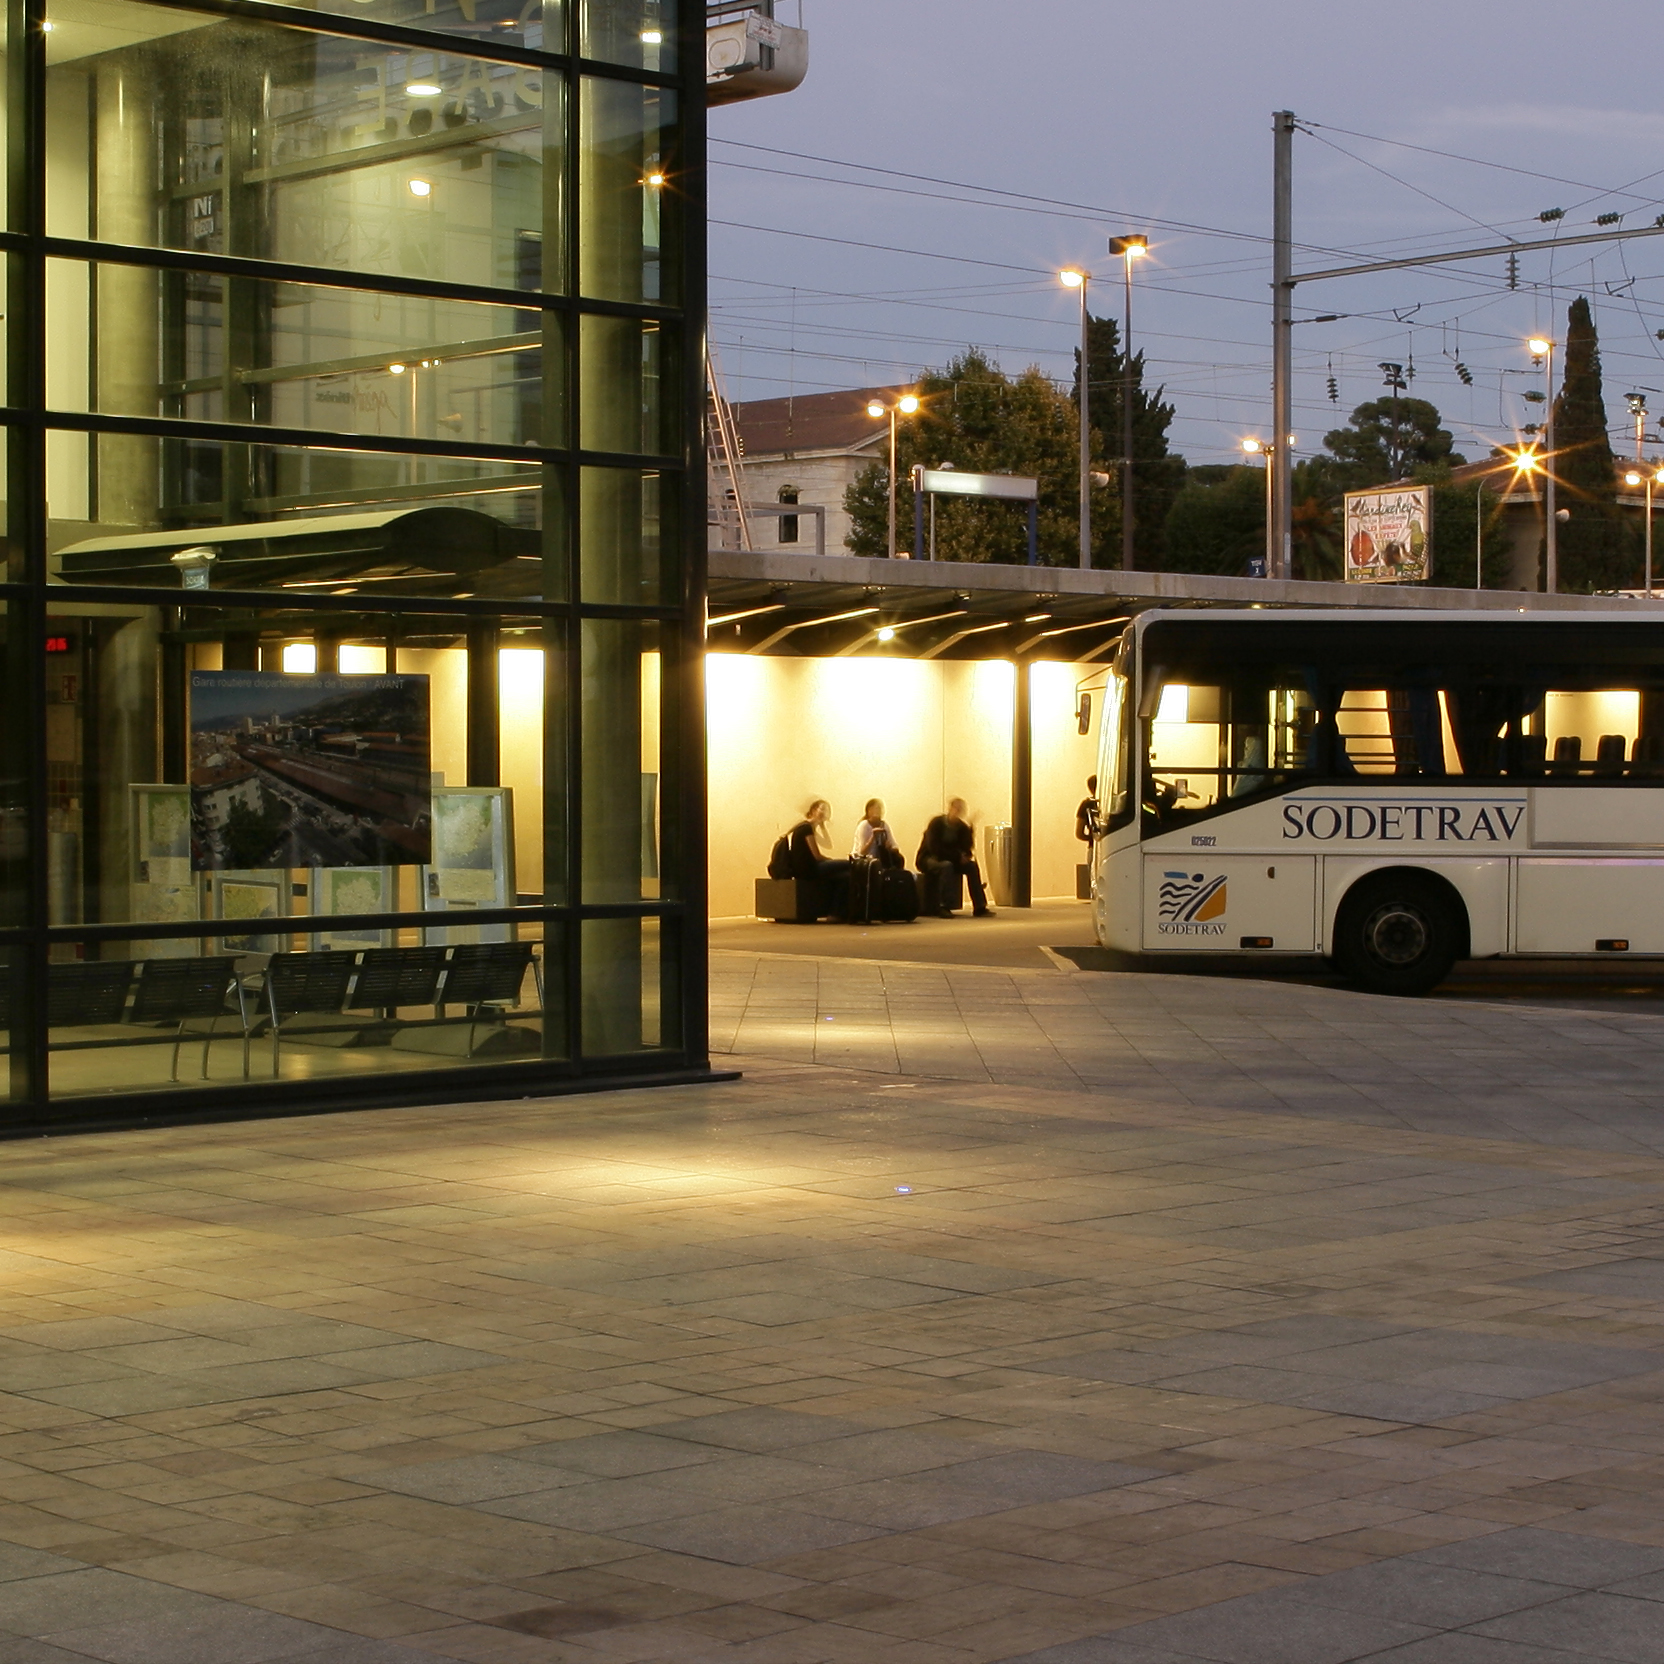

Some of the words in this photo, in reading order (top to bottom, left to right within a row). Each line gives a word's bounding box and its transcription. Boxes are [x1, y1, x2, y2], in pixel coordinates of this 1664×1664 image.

[192, 676, 216, 687] Gare
[325, 678, 337, 688] de
[339, 678, 367, 689] Toulon
[374, 679, 404, 689] AVANT
[1282, 804, 1526, 841] SODETRAV
[1157, 924, 1227, 936] SODETRAV
